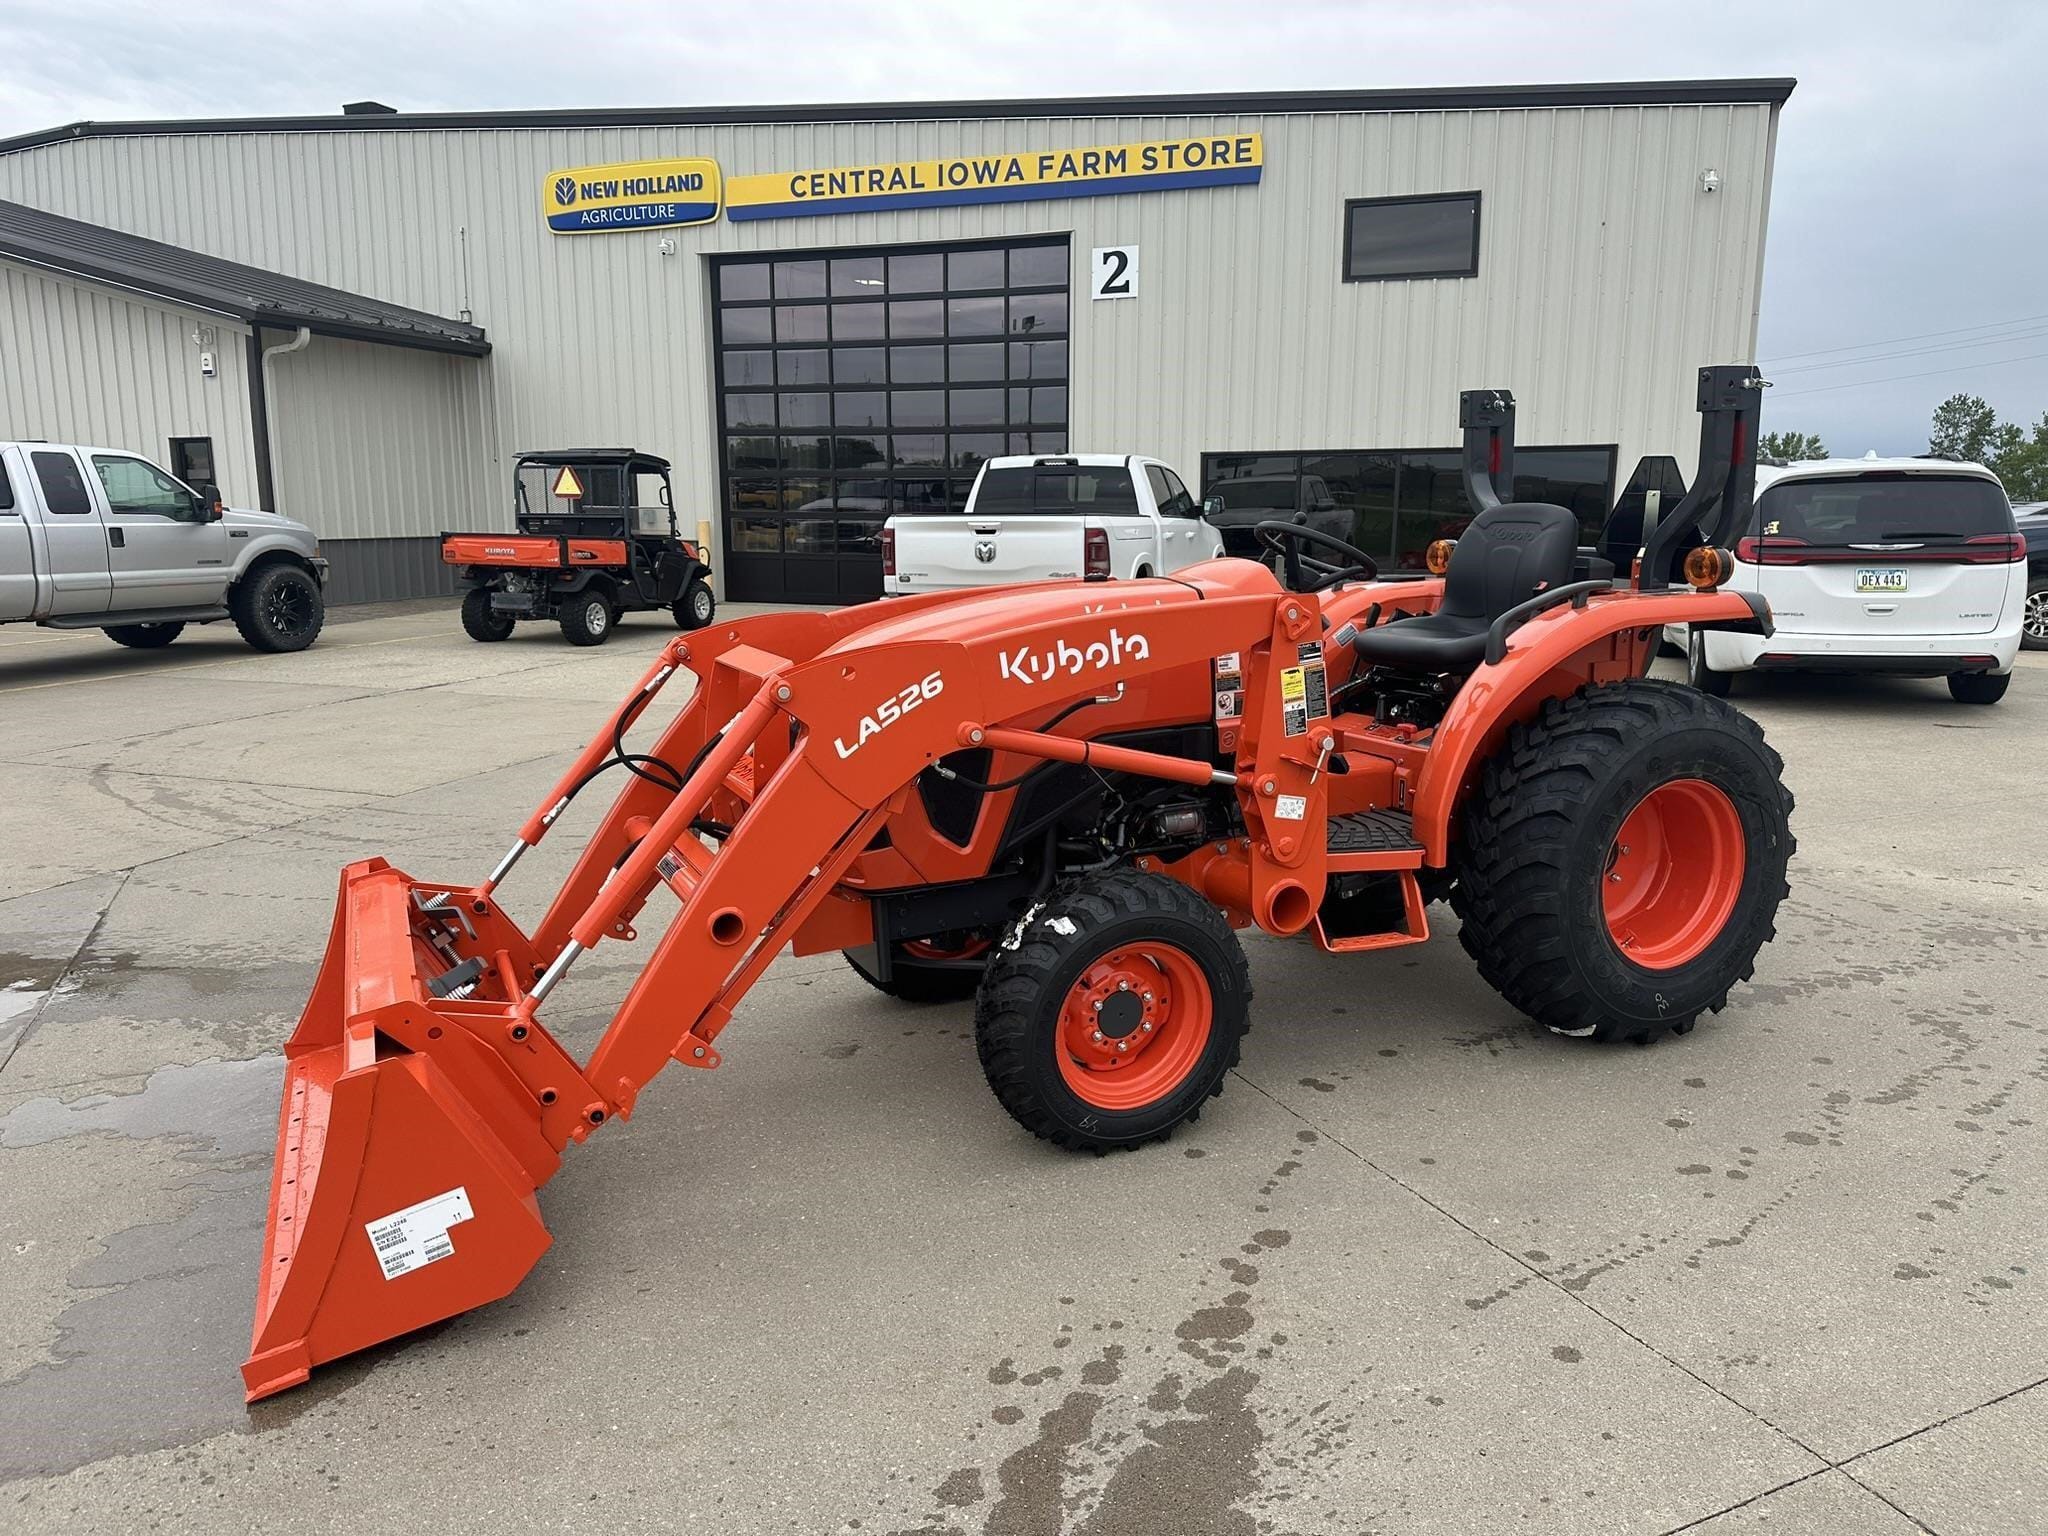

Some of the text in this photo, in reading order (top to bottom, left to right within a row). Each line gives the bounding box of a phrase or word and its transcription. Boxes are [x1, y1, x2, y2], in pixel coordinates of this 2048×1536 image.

[580, 172, 704, 200] NEW HOLLAND
[790, 138, 1253, 199] CENTRAL IOWA FARM STORE
[581, 203, 676, 224] AGRICULTURE
[1100, 250, 1131, 295] 2
[485, 547, 515, 556] KUBOTA
[1884, 575, 1902, 586] 443
[999, 628, 1150, 684] Kubota
[833, 670, 944, 760] LA526
